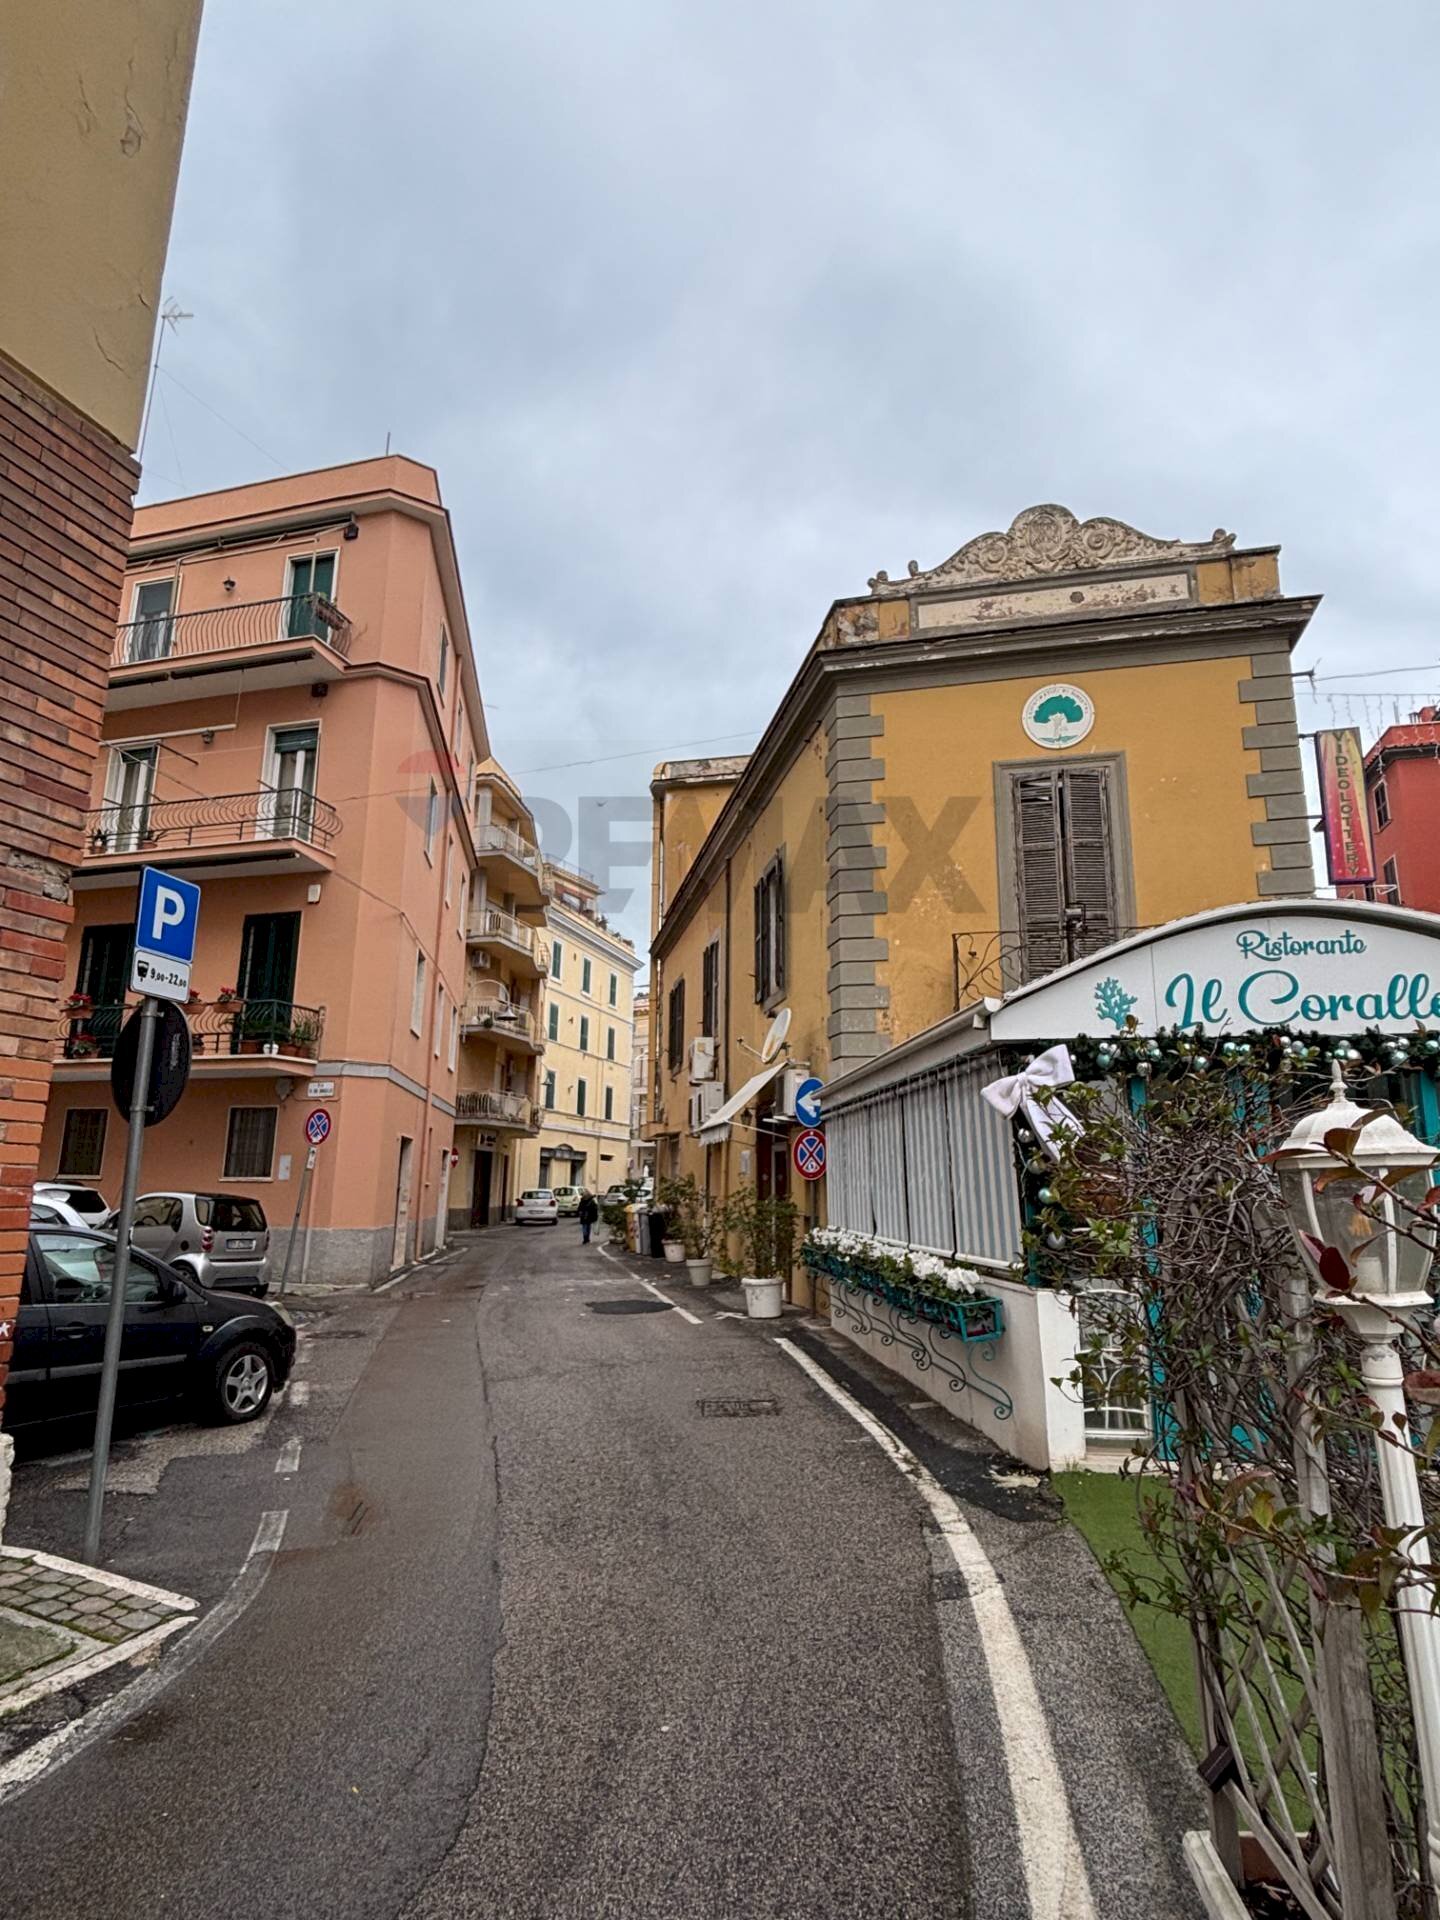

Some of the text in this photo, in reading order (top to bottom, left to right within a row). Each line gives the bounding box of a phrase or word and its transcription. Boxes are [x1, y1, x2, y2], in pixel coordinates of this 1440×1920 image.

[1331, 731, 1359, 876] VIDEOLOTTERY
[151, 885, 186, 940] P
[1236, 929, 1367, 961] Ristorante
[1165, 972, 1228, 1032] Il
